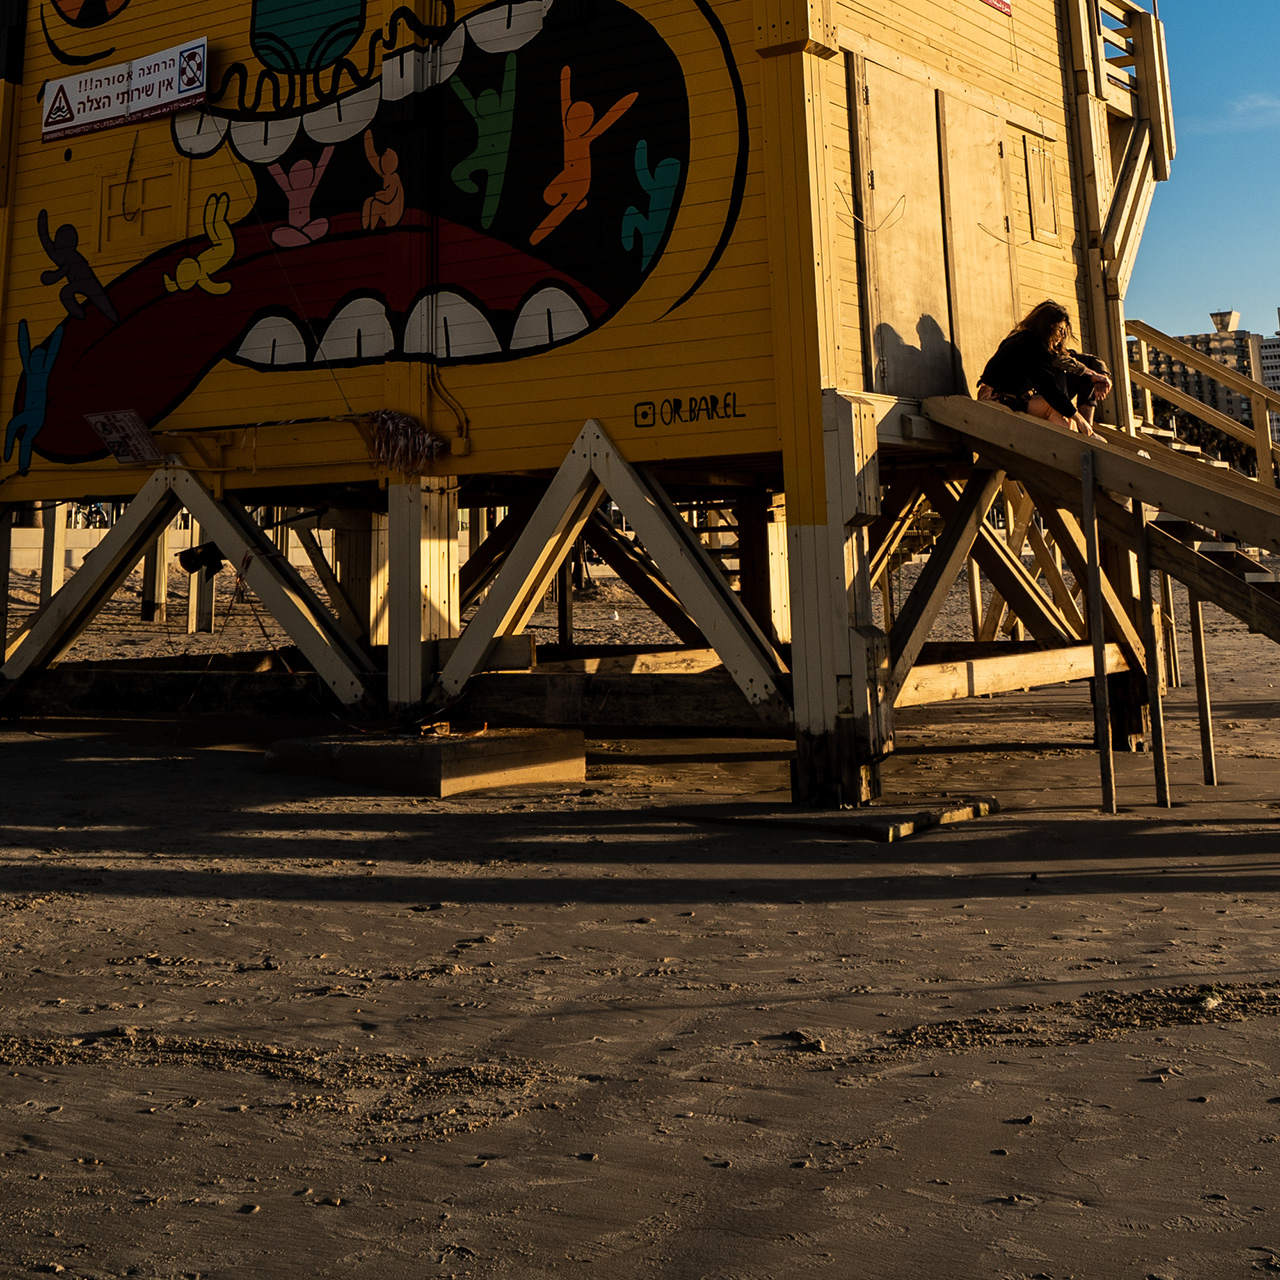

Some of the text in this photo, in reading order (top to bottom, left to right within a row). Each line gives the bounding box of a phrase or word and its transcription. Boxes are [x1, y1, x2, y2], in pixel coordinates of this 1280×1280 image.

[78, 58, 175, 93] הרחצה אסורה!!!
[77, 77, 174, 115] אין שירותי הצלה
